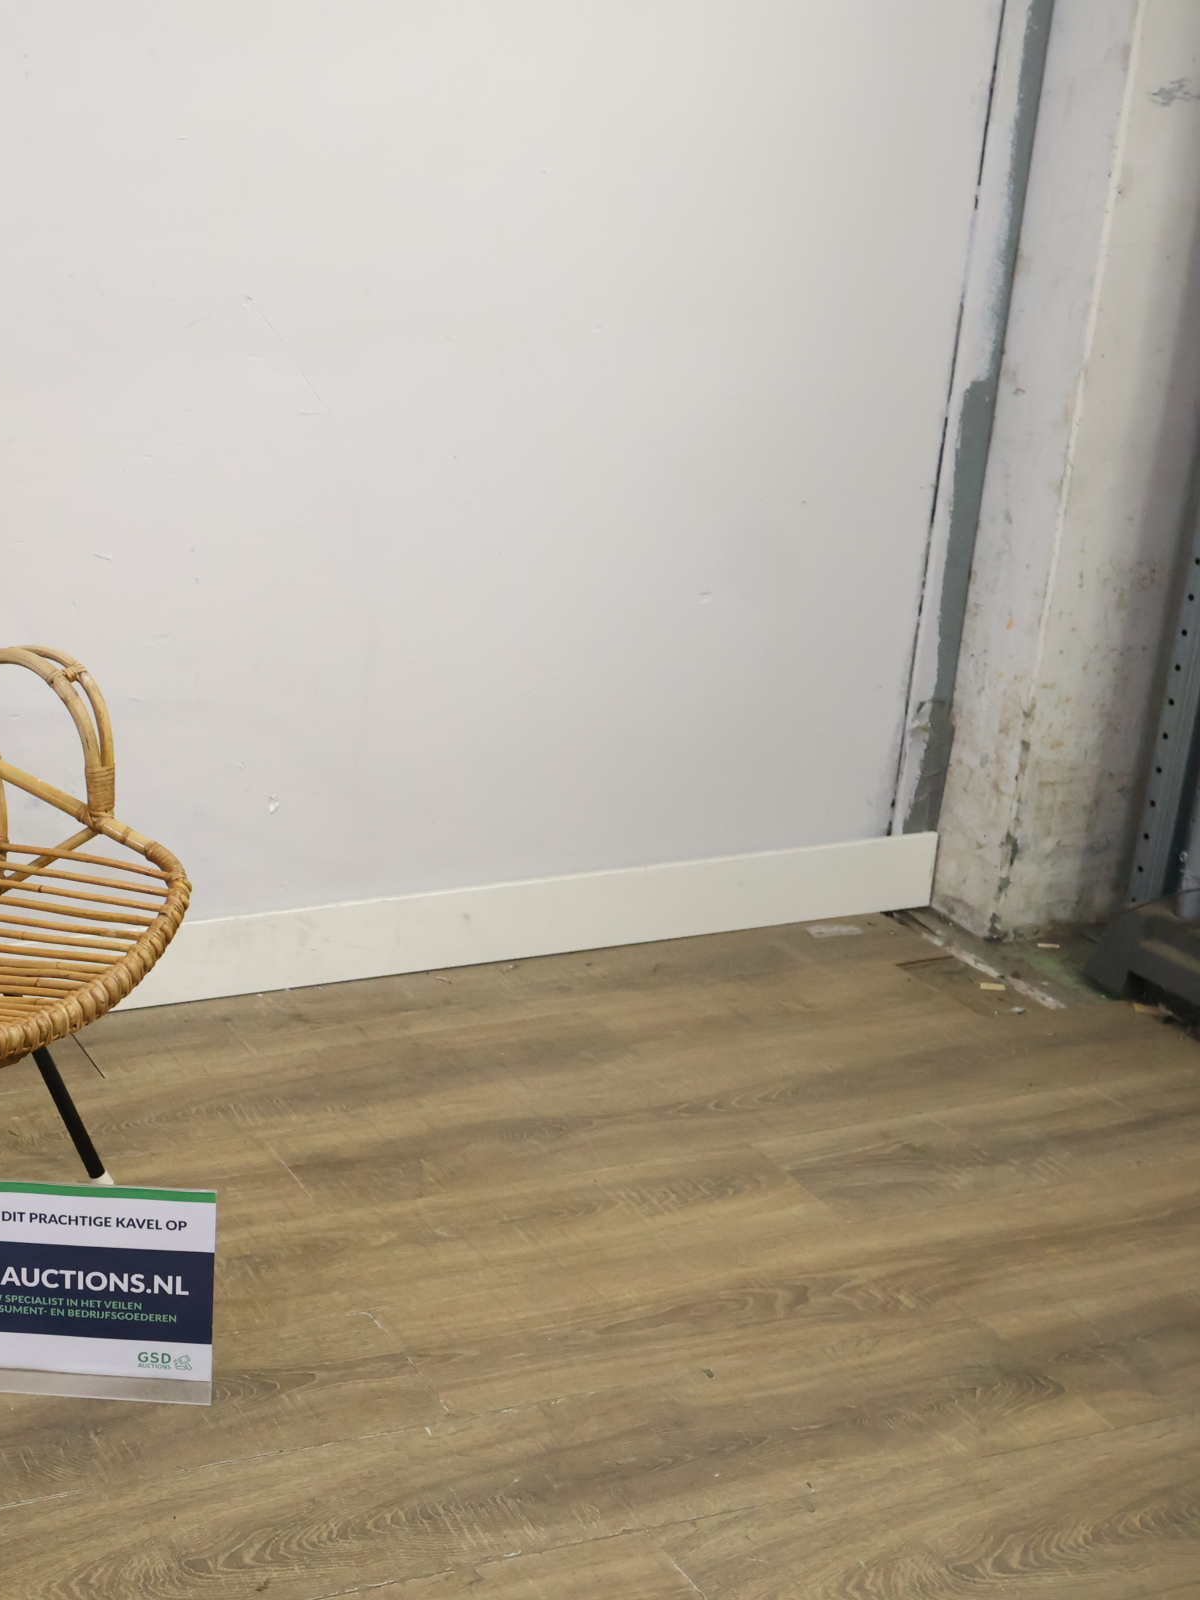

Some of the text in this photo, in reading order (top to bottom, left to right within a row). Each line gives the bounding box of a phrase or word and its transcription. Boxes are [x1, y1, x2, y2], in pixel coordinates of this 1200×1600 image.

[1, 1210, 26, 1223] DIT
[29, 1212, 112, 1228] PRACHTIGE
[116, 1217, 162, 1230] KAVEL
[165, 1220, 187, 1231] OP
[5, 1294, 64, 1306] SPECIALIST
[66, 1298, 78, 1307] IN
[80, 1299, 102, 1309] HET
[104, 1301, 143, 1311] VEILEN
[50, 1307, 65, 1317] EN
[67, 1309, 177, 1323] BEDRIJFSGOEDEREN
[137, 1352, 172, 1364] GSD
